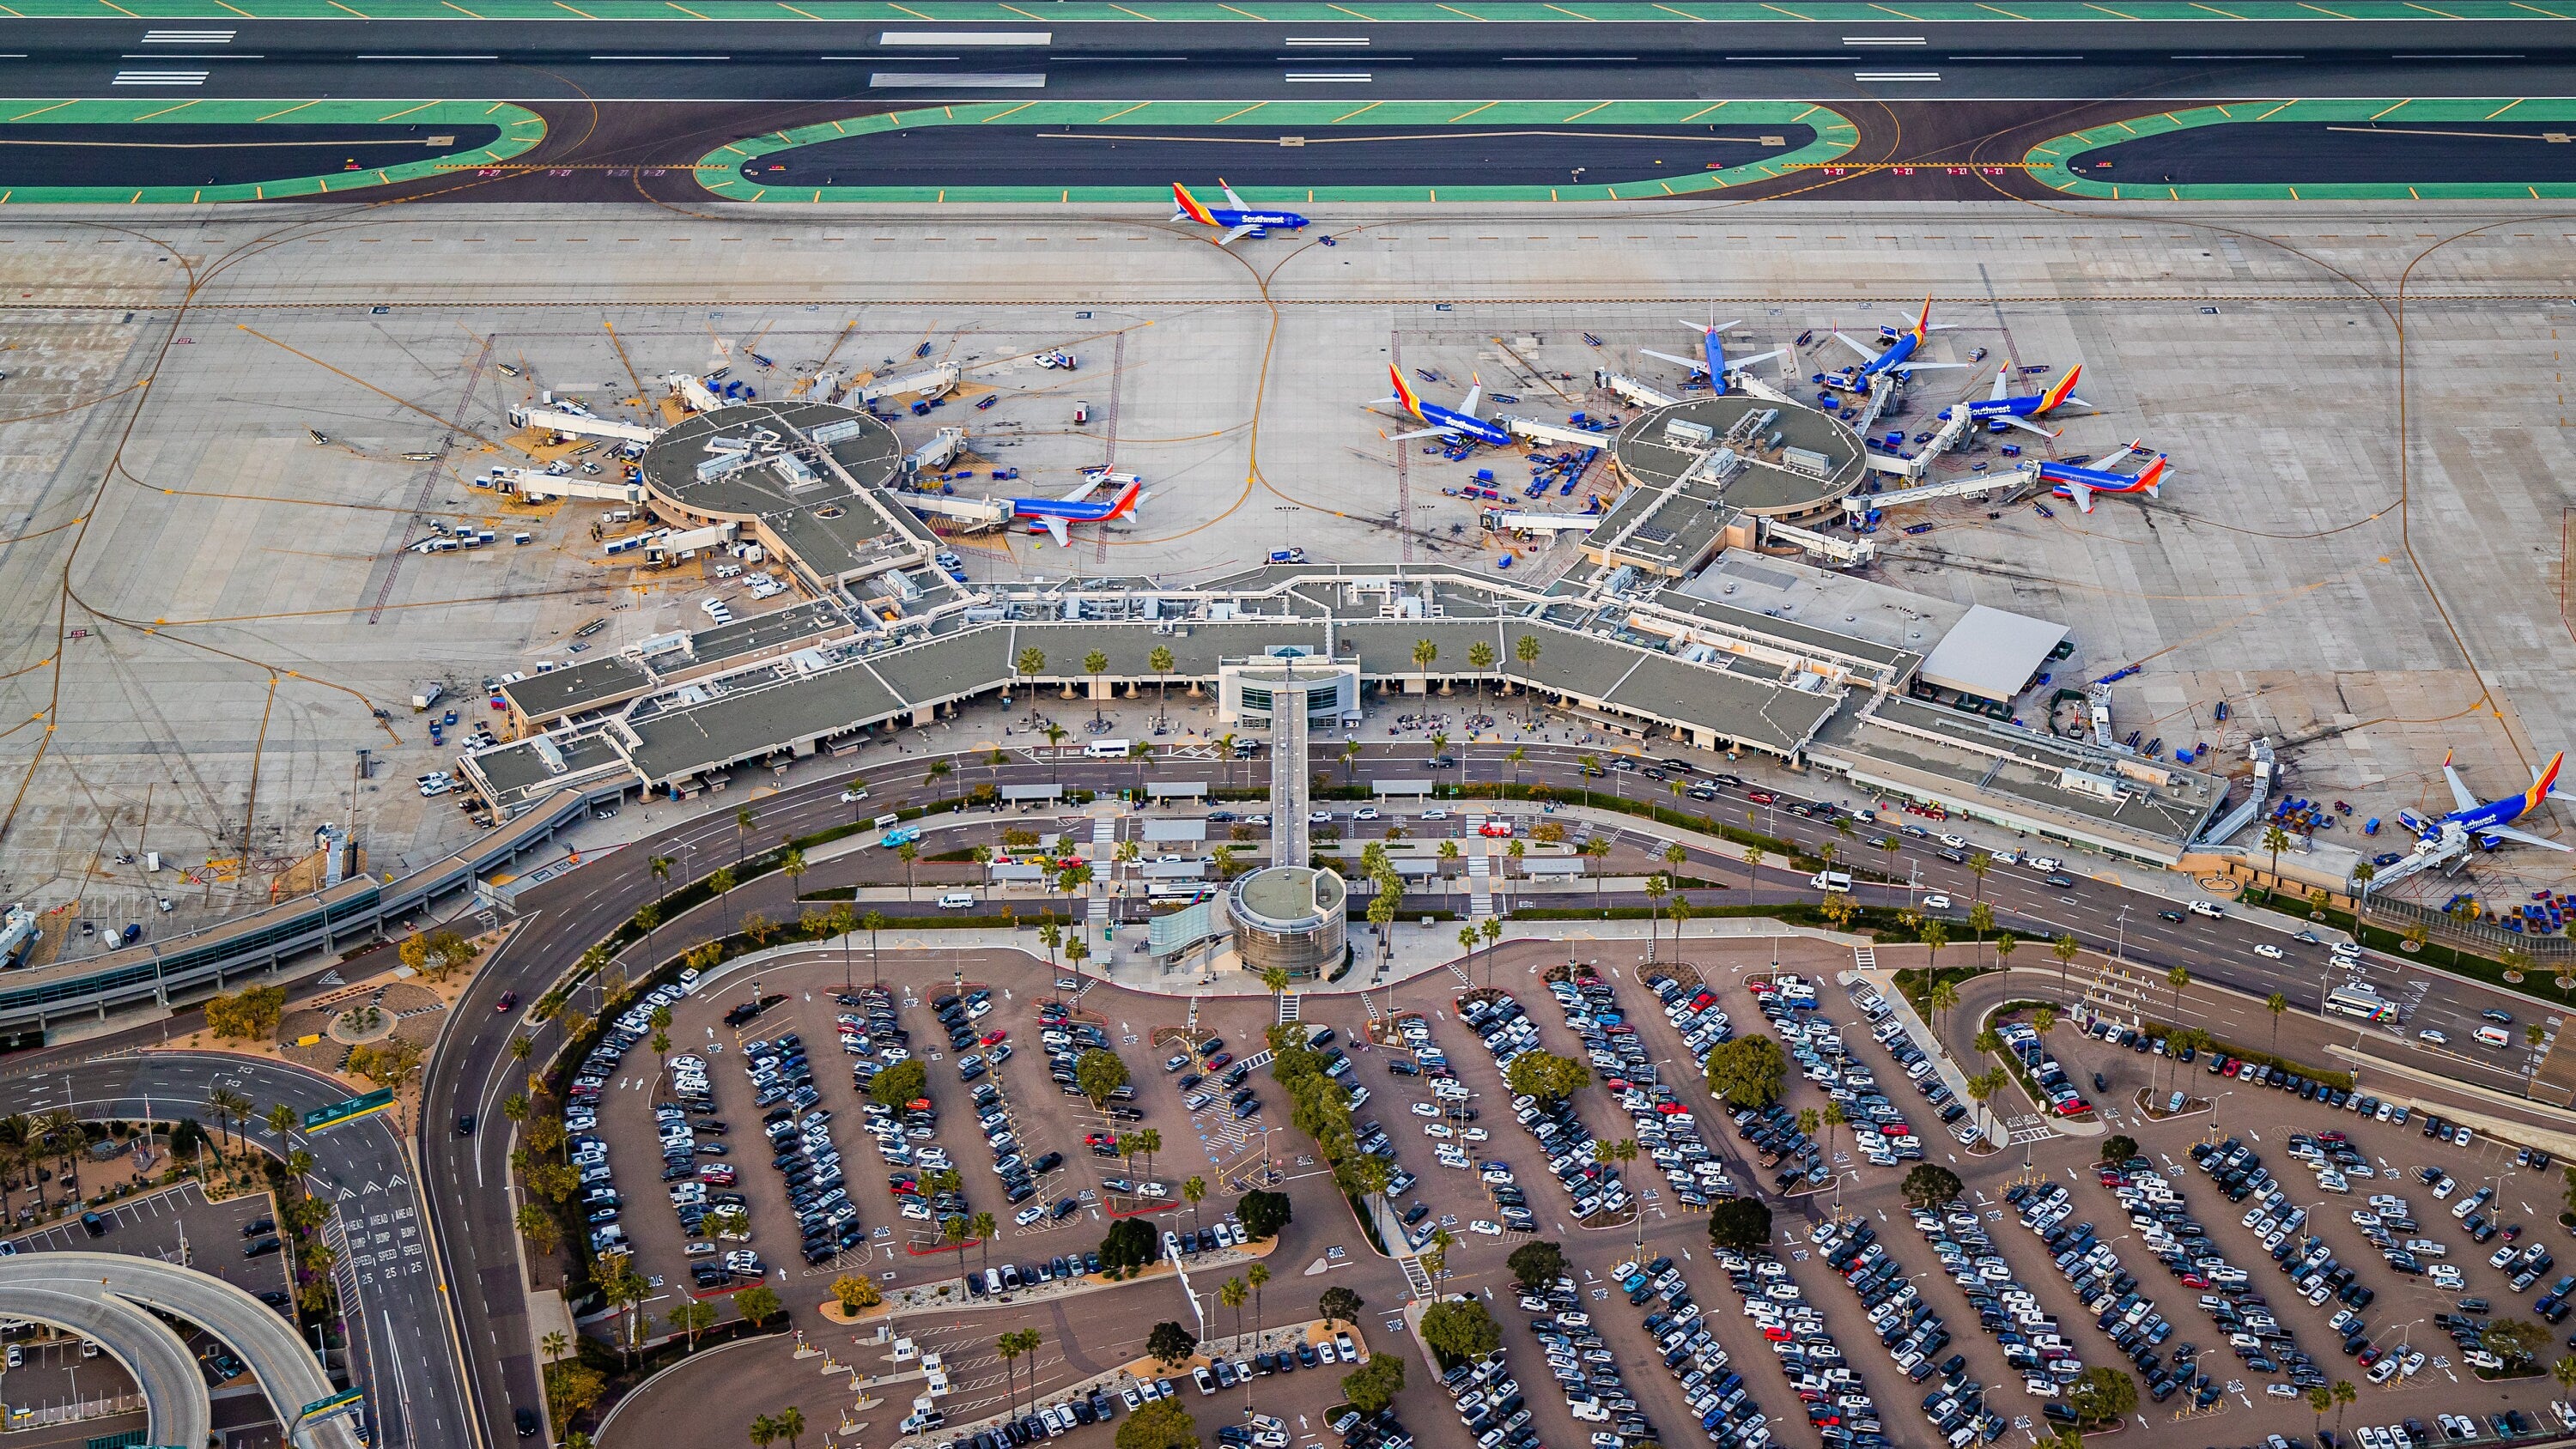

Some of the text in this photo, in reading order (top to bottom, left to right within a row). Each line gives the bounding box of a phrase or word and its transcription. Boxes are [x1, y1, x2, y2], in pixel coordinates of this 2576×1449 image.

[1242, 215, 1284, 223] Southwest
[1445, 415, 1485, 435] Southwest
[2460, 813, 2497, 831] outhwest
[903, 997, 919, 1009] STOP
[1123, 1034, 1139, 1046] STOP
[707, 1043, 723, 1054] STOP
[2023, 1113, 2040, 1125] STOP
[2103, 1107, 2121, 1119] STOP
[2007, 1116, 2023, 1128] STOP
[1297, 1155, 1314, 1166] STOP
[1833, 1151, 1850, 1163] STOP
[2167, 1164, 2186, 1177] STOP
[2383, 1167, 2402, 1180] STOP
[1642, 1188, 1659, 1200] STOP
[395, 1207, 414, 1220] AHEAD
[1985, 1210, 2004, 1222] STOP
[345, 1219, 364, 1232] AHEAD
[370, 1214, 389, 1227] AHEAD
[1440, 1214, 1458, 1227] STOP
[375, 1232, 391, 1244] BUMP
[400, 1226, 416, 1239] BUMP
[873, 1226, 890, 1238] STOP
[351, 1237, 366, 1250] BUMP
[403, 1243, 422, 1256] SPEED
[378, 1248, 398, 1262] SPEED
[1328, 1246, 1346, 1258] STOP
[1792, 1249, 1809, 1262] STOP
[353, 1254, 373, 1267] SPEED
[385, 1266, 397, 1279] 25
[410, 1261, 423, 1274] 25
[361, 1272, 374, 1284] 25
[1591, 1288, 1609, 1300] STOP
[1386, 1319, 1403, 1332] STOP
[2431, 1355, 2451, 1368] STOP
[2226, 1379, 2245, 1393] STOP
[2014, 1415, 2032, 1429] STOP
